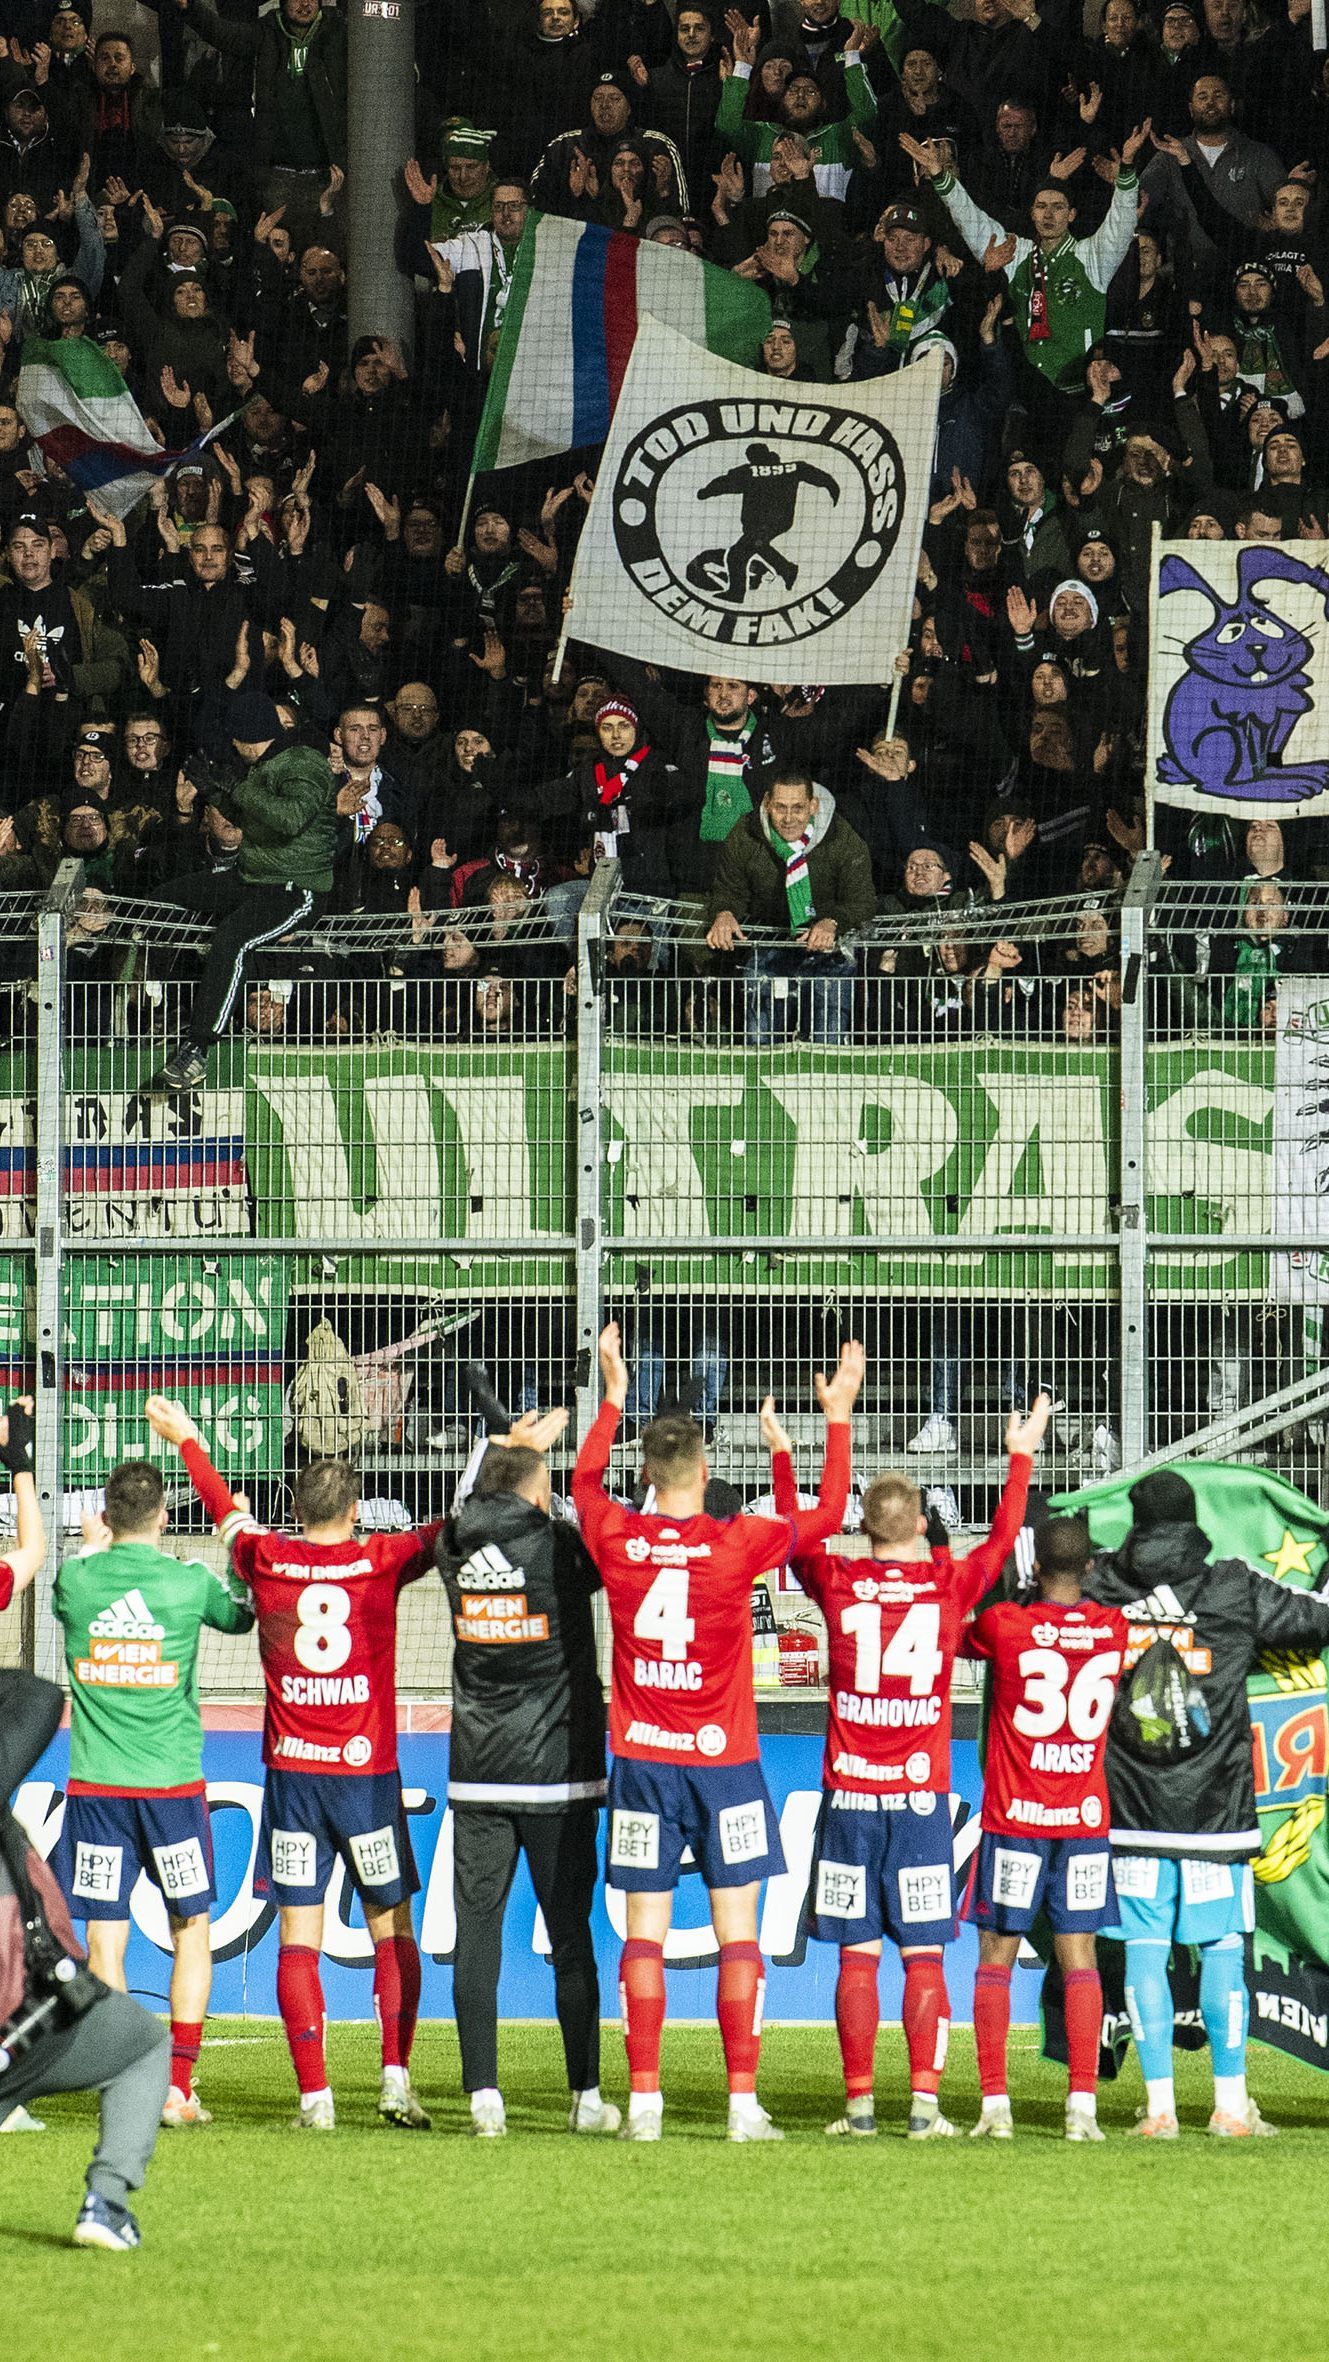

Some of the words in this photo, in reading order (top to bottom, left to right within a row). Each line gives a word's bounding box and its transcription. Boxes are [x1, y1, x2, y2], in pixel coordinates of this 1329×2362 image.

[622, 411, 710, 488] TOD
[719, 403, 831, 437] UND
[829, 416, 898, 533] HASS
[630, 557, 725, 638] DEM
[731, 587, 845, 643] FAK!
[456, 1568, 526, 1590] adidas
[465, 1597, 523, 1618] WIEN
[634, 1567, 695, 1660] 4
[88, 1620, 165, 1641] adidas
[294, 1583, 352, 1674] 8
[456, 1617, 545, 1640] ENERGIE
[94, 1643, 158, 1664] WIEN
[841, 1602, 943, 1696] 14
[78, 1661, 176, 1685] ENERGIE
[634, 1657, 702, 1691] BARAC
[281, 1675, 370, 1706] SCHWAB
[1013, 1649, 1121, 1741] 36
[836, 1691, 942, 1727] GRAHOVAC
[625, 1720, 696, 1752] Allianz
[273, 1735, 341, 1763] Allianz
[833, 1752, 904, 1781] Allianz
[726, 1814, 757, 1834] HPY
[1006, 1798, 1081, 1827] Allianz
[619, 1820, 653, 1838] HPY
[275, 1840, 310, 1858] HPY
[358, 1837, 390, 1860] HPY
[618, 1839, 650, 1857] BET
[729, 1831, 759, 1853] BET
[81, 1852, 116, 1872] HPY
[161, 1848, 195, 1871] HPY
[275, 1857, 309, 1876] BET
[362, 1855, 393, 1877] BET
[1001, 1860, 1033, 1879] HPY
[79, 1870, 113, 1890] BET
[166, 1866, 201, 1889] BET
[824, 1871, 859, 1891] HPY
[907, 1875, 944, 1893] HPY
[908, 1893, 944, 1912] BET
